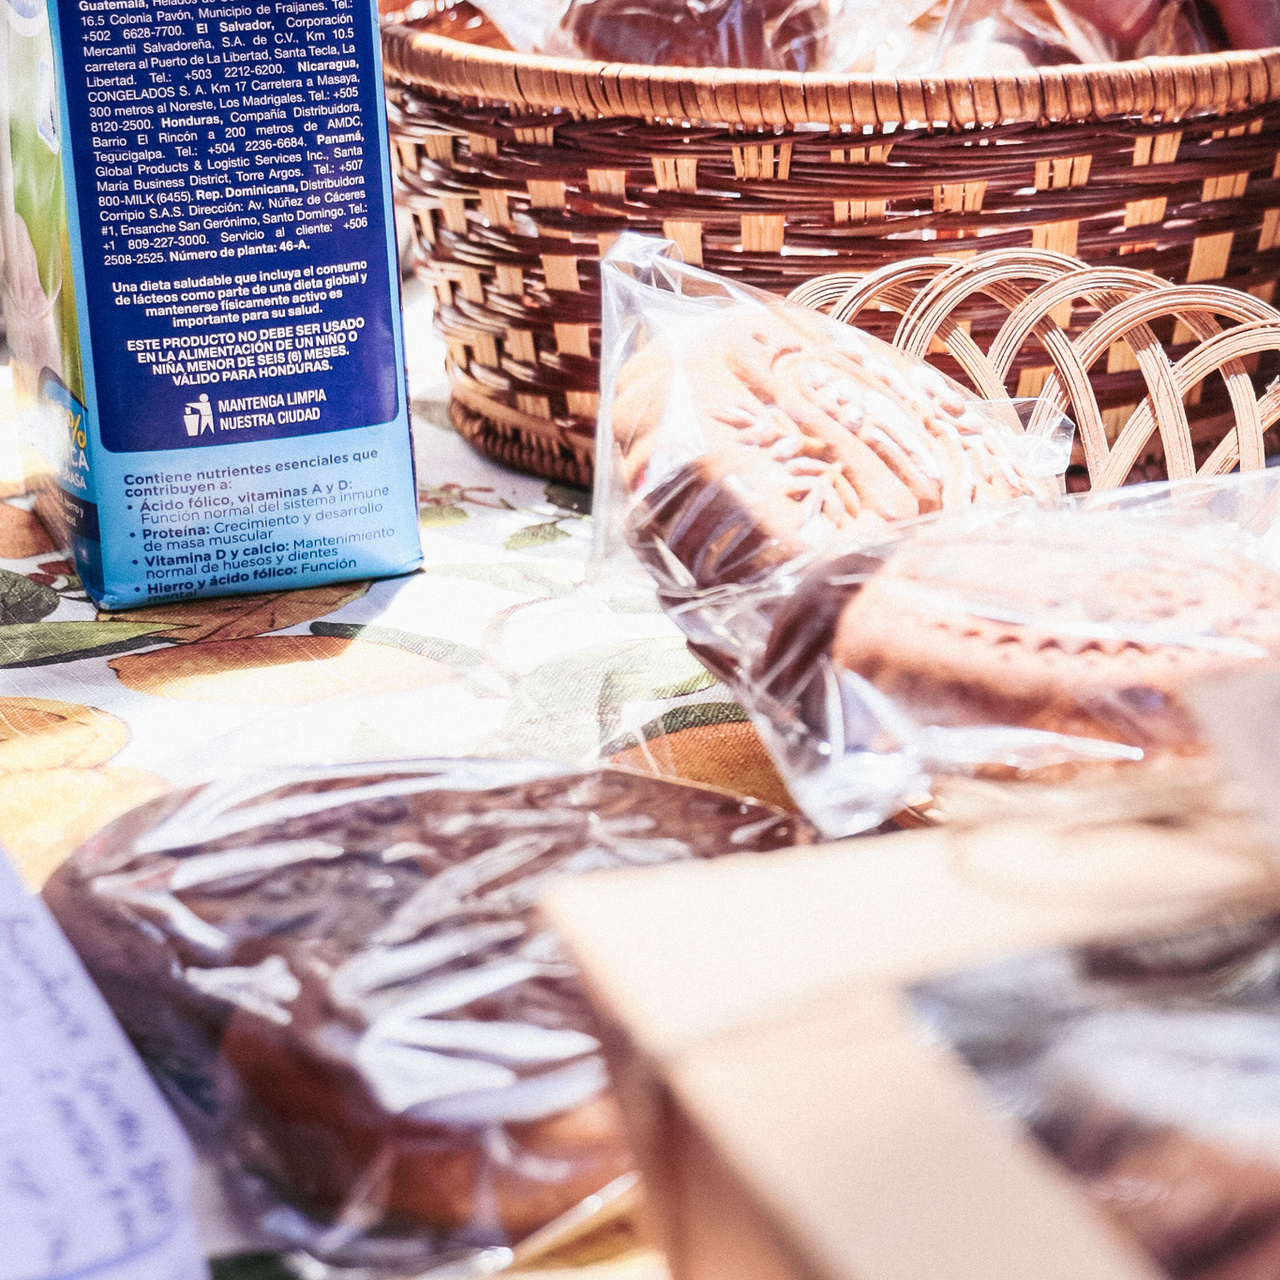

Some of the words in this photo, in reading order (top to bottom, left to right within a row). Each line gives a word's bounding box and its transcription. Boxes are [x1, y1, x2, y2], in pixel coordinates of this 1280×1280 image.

[82, 30, 110, 41] +502
[122, 25, 184, 39] 6628-7700.
[196, 23, 208, 33] El
[219, 19, 274, 32] Salvador,
[286, 13, 353, 28] Corporación
[86, 74, 136, 87] Libertad.
[148, 72, 171, 83] Tel.:
[184, 68, 212, 80] +503
[224, 63, 285, 77] 2212-6200.
[297, 59, 359, 72] Nicaragua,
[91, 118, 154, 132] 8120-2500.
[161, 115, 223, 128] Honduras,
[230, 108, 286, 122] Compañía
[293, 102, 362, 117] Distribuidora,
[94, 149, 165, 164] Tegucigalpa.
[174, 145, 197, 156] Tel.:
[207, 142, 235, 154] +504
[245, 136, 307, 151] 2236-6684.
[316, 129, 364, 145] Panamá,
[98, 193, 155, 206] 800-MILK
[156, 190, 193, 205] (6455).
[195, 189, 223, 201] Rep.
[225, 183, 298, 197] Dominicana,
[300, 175, 364, 191] Distribuidora
[103, 240, 114, 250] +1
[128, 234, 209, 249] 809-227-3000.
[220, 229, 264, 242] Servicio
[275, 226, 285, 237] al
[295, 223, 332, 235] cliente:
[343, 216, 367, 229] +506
[104, 252, 166, 265] 2508-2525.
[169, 250, 217, 261] Número
[219, 246, 235, 257] de
[236, 243, 277, 258] planta:
[278, 239, 310, 251] 46-A.
[112, 281, 137, 292] Una
[139, 280, 171, 291] dieta
[173, 274, 232, 289] saludable
[234, 273, 257, 285] que
[259, 268, 301, 281] incluya
[303, 265, 314, 276] el
[315, 260, 367, 275] consumo
[114, 294, 130, 305] de
[132, 293, 178, 304] lácteos
[180, 290, 215, 301] como
[217, 286, 249, 300] parte
[251, 283, 267, 294] de
[269, 282, 291, 293] una
[293, 278, 323, 290] dieta
[324, 272, 359, 289] global
[360, 273, 367, 284] y
[145, 303, 218, 316] mantenerse
[220, 294, 289, 310] físicamente
[291, 290, 327, 303] activo
[328, 289, 342, 299] es
[172, 312, 239, 328] importante
[241, 310, 269, 323] para
[270, 309, 285, 318] su
[287, 302, 322, 316] salud.
[126, 338, 160, 351] ESTE
[162, 332, 235, 348] PRODUCTO
[237, 330, 257, 341] NO
[259, 326, 293, 339] DEBE
[295, 322, 320, 335] SER
[322, 317, 364, 332] USADO
[137, 351, 156, 363] EN
[158, 350, 176, 362] LA
[177, 340, 273, 360] ALIMENTACIÓN
[275, 338, 293, 350] DE
[294, 336, 313, 348] UN
[315, 329, 346, 346] NIÑO
[347, 330, 357, 342] O
[152, 359, 185, 375] NIÑA
[186, 357, 235, 372] MENOR
[237, 355, 255, 367] DE
[257, 352, 285, 365] SEIS
[287, 350, 302, 363] (6)
[303, 344, 349, 360] MESES.
[172, 371, 219, 386] VÁLIDO
[221, 368, 257, 381] PARA
[258, 359, 333, 378] HONDURAS.
[218, 393, 285, 412] MANTENGA
[286, 388, 326, 405] LIMPIA
[219, 412, 275, 430] NUESTRA
[277, 407, 320, 424] CIUDAD
[123, 472, 191, 485] Contiene
[196, 464, 271, 479] nutrientes
[275, 454, 348, 471] esenciales
[352, 449, 377, 462] que
[124, 483, 215, 497] contribuyen
[220, 481, 231, 489] a:
[139, 499, 183, 512] Ácido
[188, 495, 233, 508] fólico,
[238, 487, 307, 502] vitaminas
[312, 483, 321, 494] A
[326, 484, 333, 494] y
[338, 480, 352, 490] D:
[141, 511, 199, 524] Función
[204, 502, 253, 519] normal
[258, 500, 279, 512] del
[283, 495, 335, 510] sistema
[340, 486, 389, 502] inmune
[142, 525, 209, 540] Proteína:
[214, 515, 299, 533] Crecimiento
[303, 514, 310, 524] y
[315, 502, 383, 520] desarrollo
[143, 540, 162, 552] de
[166, 538, 204, 550] masa
[209, 529, 273, 545] muscular
[144, 552, 211, 567] Vitamina
[215, 549, 226, 560] D
[230, 549, 238, 560] y
[242, 542, 289, 556] calcio:
[293, 528, 394, 550] Mantenimiento
[145, 563, 196, 579] normal
[201, 562, 219, 573] de
[223, 556, 271, 570] huesos
[275, 555, 284, 565] y
[288, 547, 338, 561] dientes
[147, 581, 194, 594] Hierro
[197, 579, 206, 590] y
[209, 571, 249, 586] ácido
[252, 566, 297, 580] fólico:
[301, 557, 356, 573] Función
